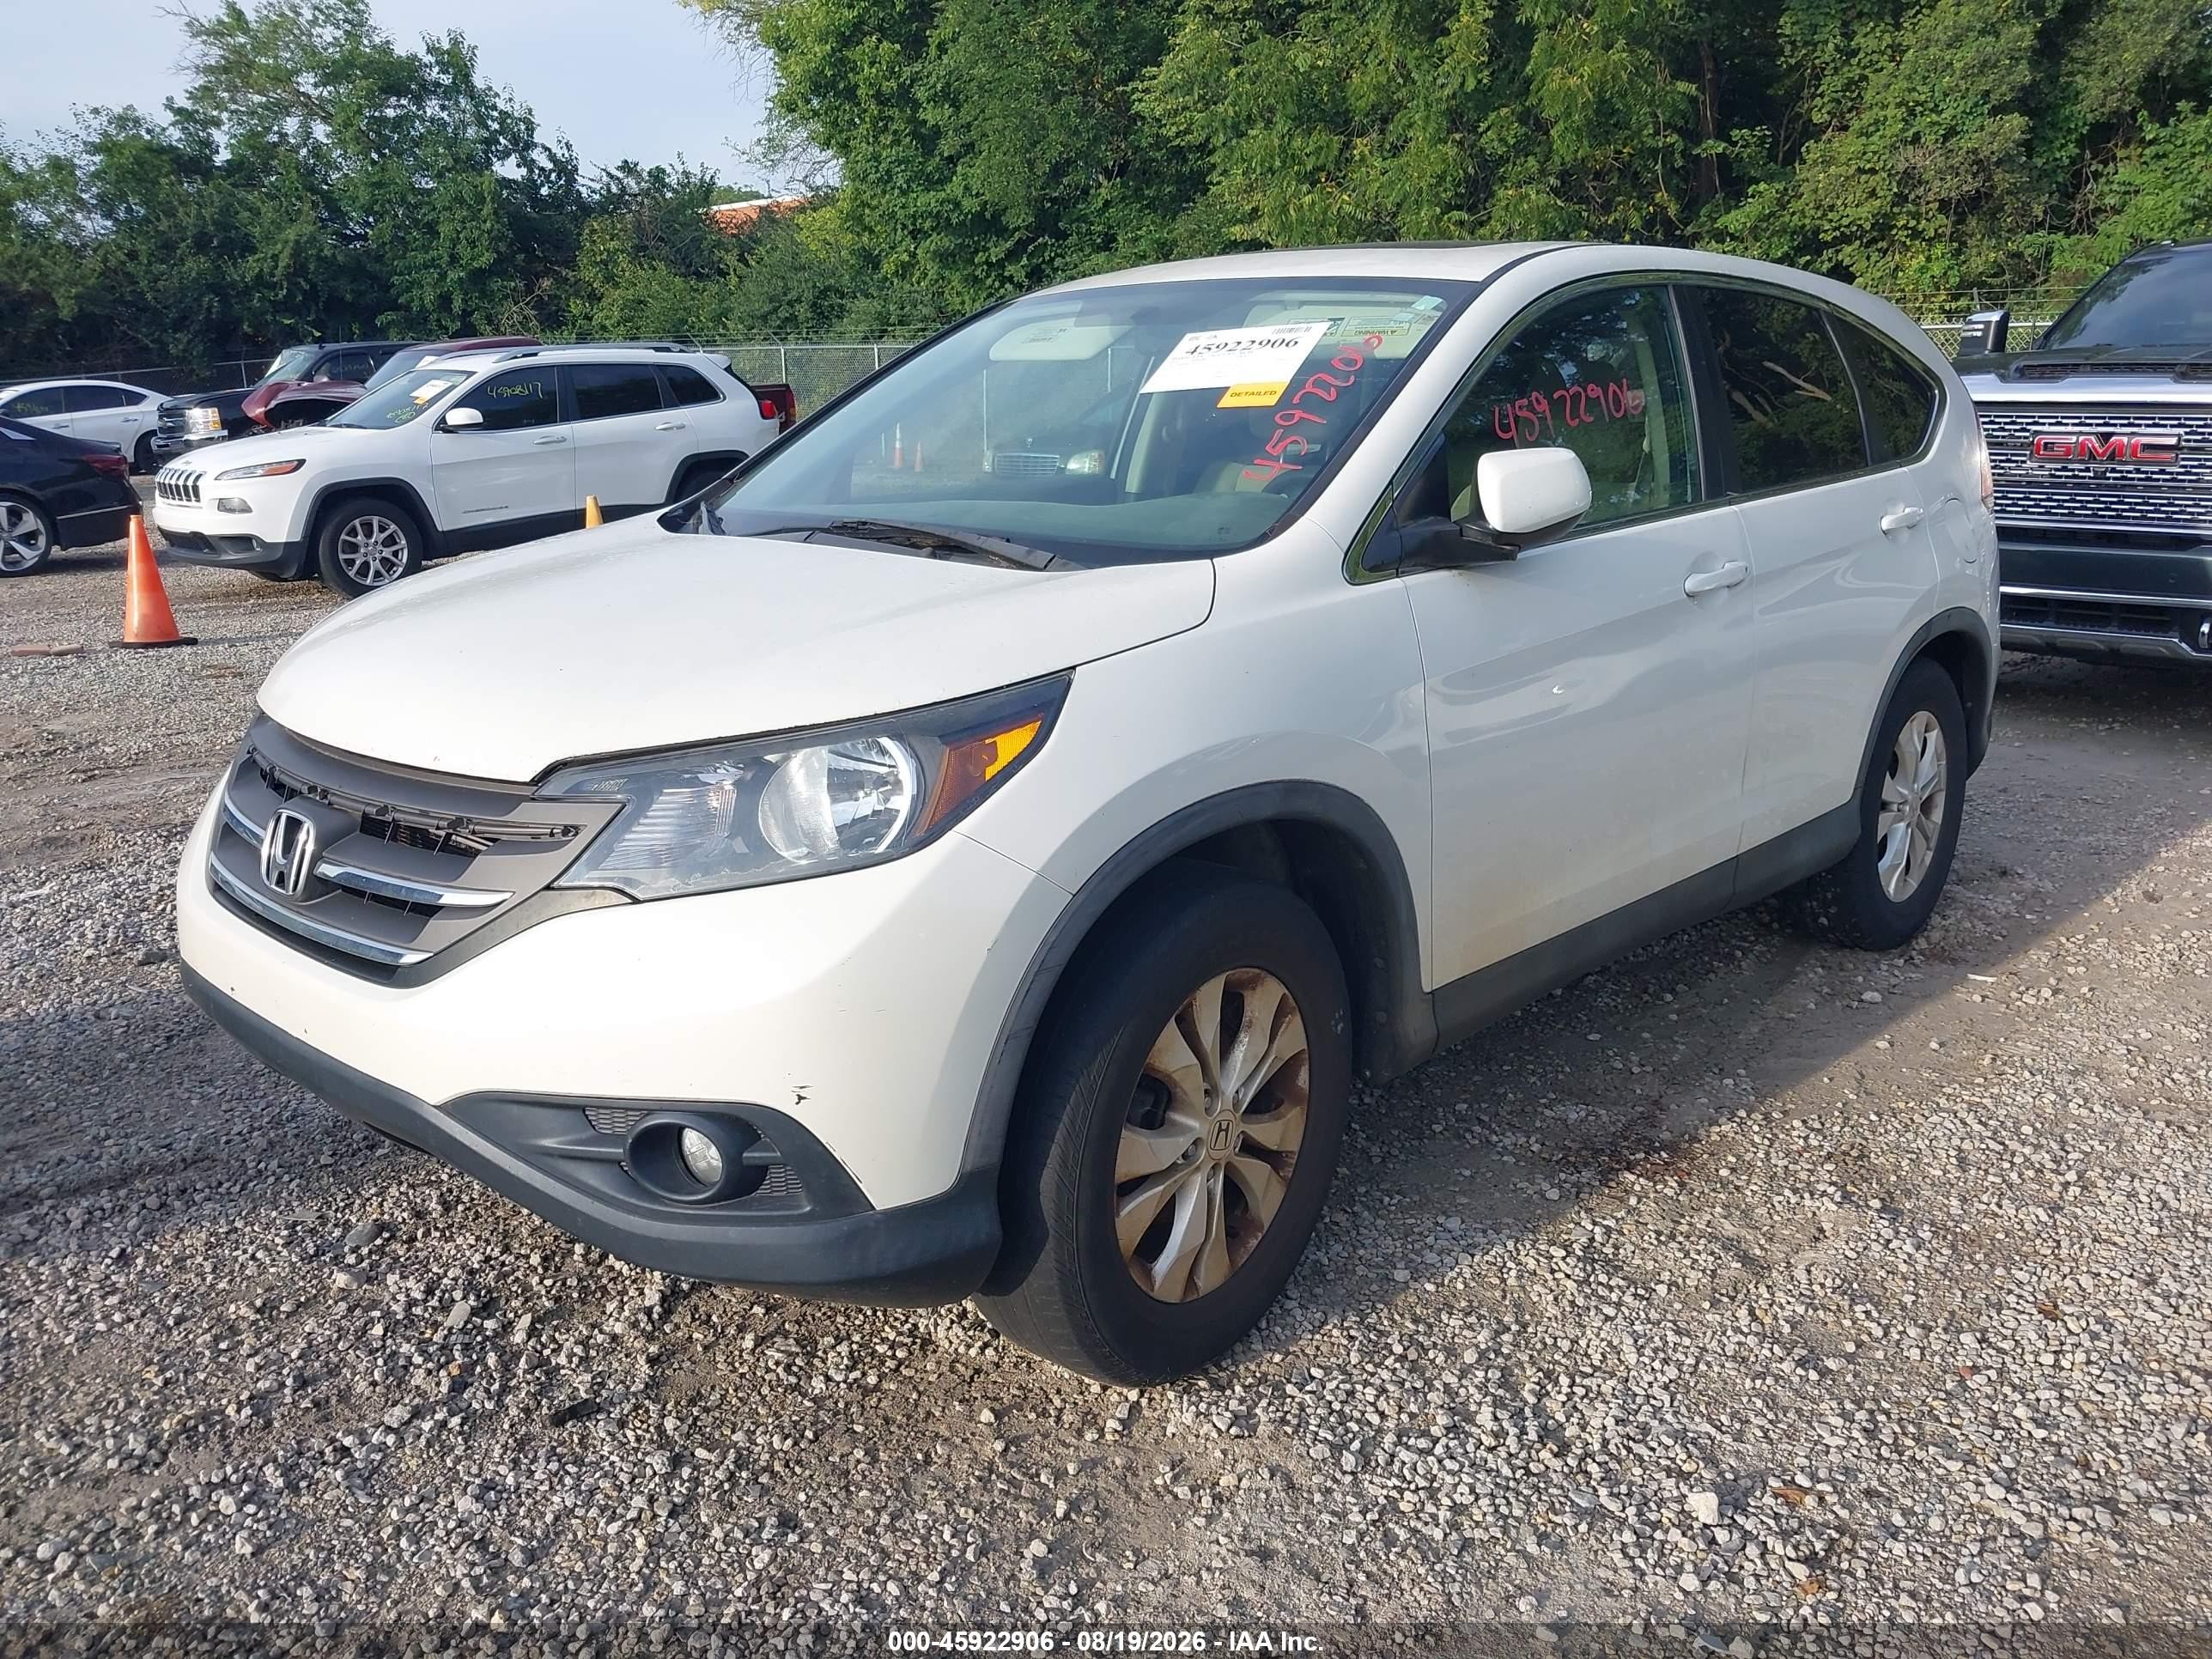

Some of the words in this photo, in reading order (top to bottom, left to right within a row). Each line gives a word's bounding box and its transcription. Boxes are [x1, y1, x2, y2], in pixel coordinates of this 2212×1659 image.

[1185, 336, 1302, 356] 45922906
[1493, 377, 1644, 448] 45922906
[2034, 434, 2179, 462] GMC
